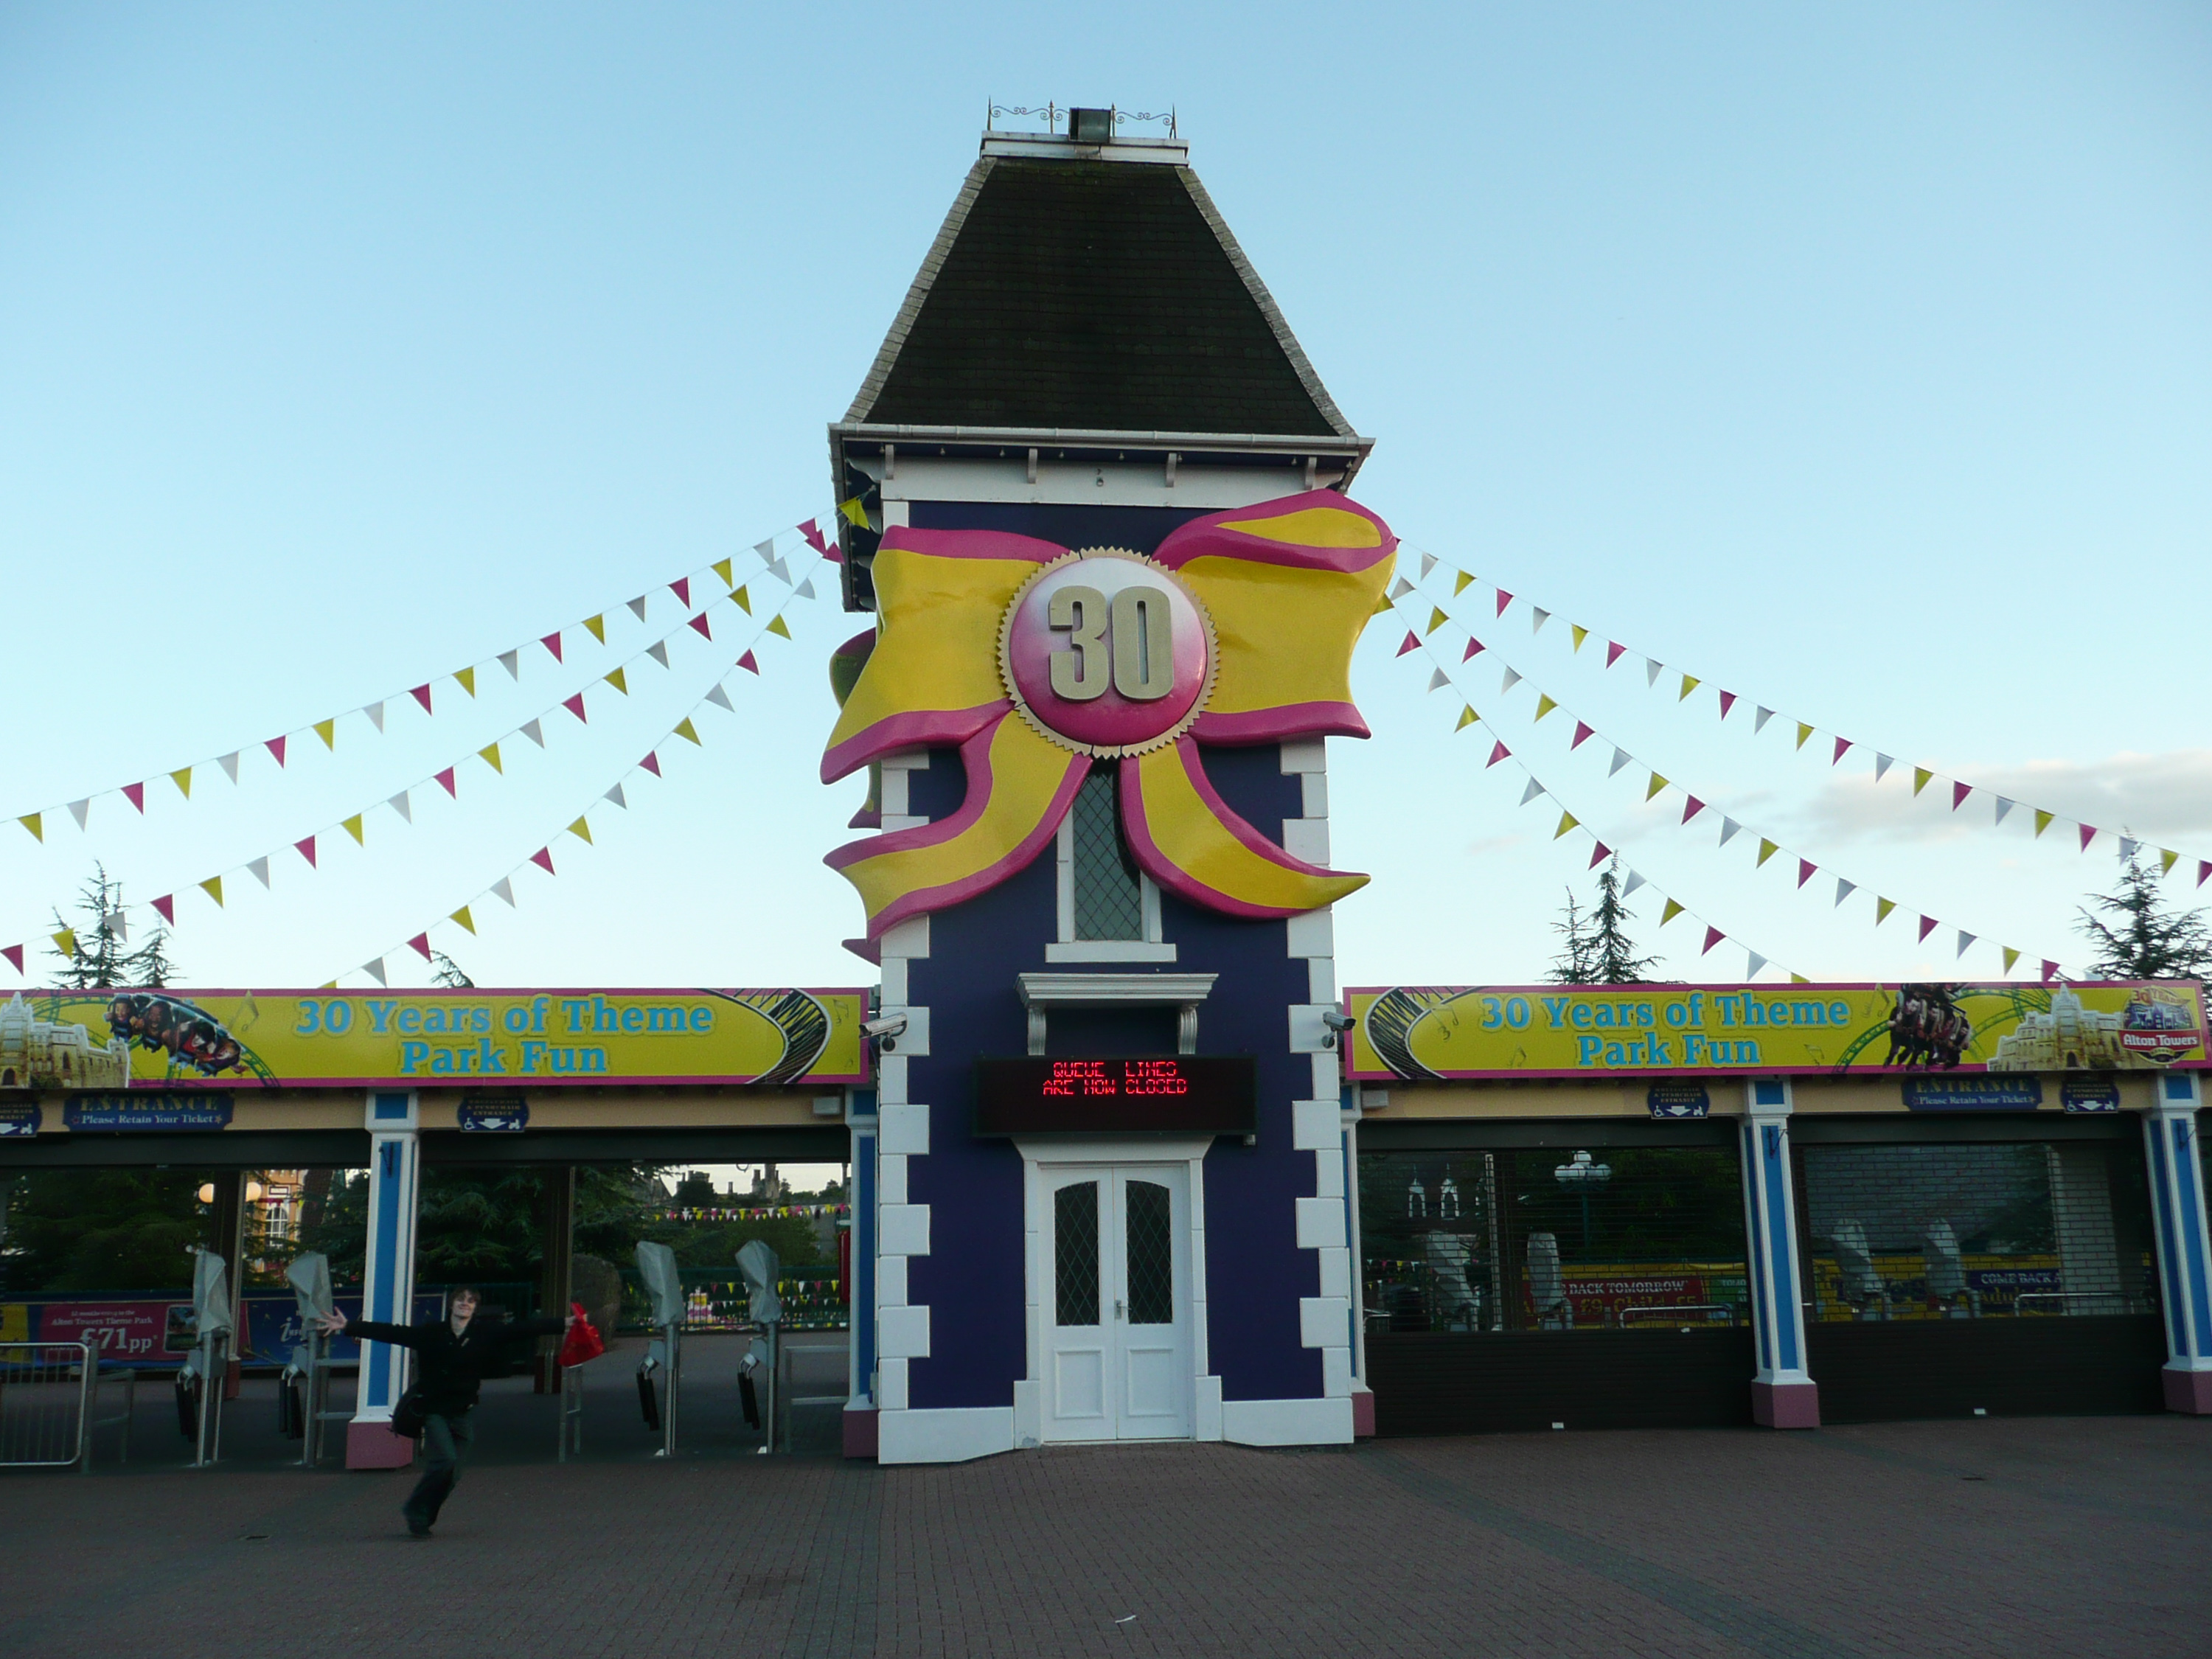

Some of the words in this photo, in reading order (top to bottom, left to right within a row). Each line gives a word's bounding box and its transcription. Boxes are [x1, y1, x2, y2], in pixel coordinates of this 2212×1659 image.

[1048, 585, 1174, 700] 30
[2132, 990, 2151, 1004] 30
[296, 1000, 352, 1033] 30
[366, 1001, 491, 1033] Years
[505, 997, 549, 1032] of
[561, 996, 713, 1032] Theme
[1481, 998, 1531, 1029] 30
[1541, 997, 1655, 1028] Years
[1665, 993, 1703, 1026] of
[1715, 992, 1849, 1026] Theme
[2124, 1034, 2157, 1046] Alton
[2155, 1034, 2197, 1046] Towers
[400, 1037, 507, 1074] Park
[520, 1040, 608, 1073] Fun
[1577, 1032, 1671, 1066] Park
[1683, 1034, 1761, 1065] Fun
[1053, 1062, 1105, 1077] QUEUE
[1125, 1061, 1177, 1077] LINES
[1043, 1079, 1074, 1096] ARE
[1084, 1079, 1116, 1095] NOW
[1125, 1079, 1188, 1095] CLOSED
[1916, 1079, 2028, 1093] ENTRANCE
[80, 1096, 218, 1111] ENTRANCE
[1919, 1096, 1947, 1105] Please
[1950, 1096, 1977, 1104] Retain
[1978, 1095, 1999, 1104] Your
[2000, 1095, 2028, 1103] Ticket
[82, 1115, 116, 1124] Please
[119, 1115, 152, 1124] Retain
[155, 1115, 178, 1124] Your
[181, 1114, 213, 1123] Ticket
[1568, 1283, 1604, 1295] BACK
